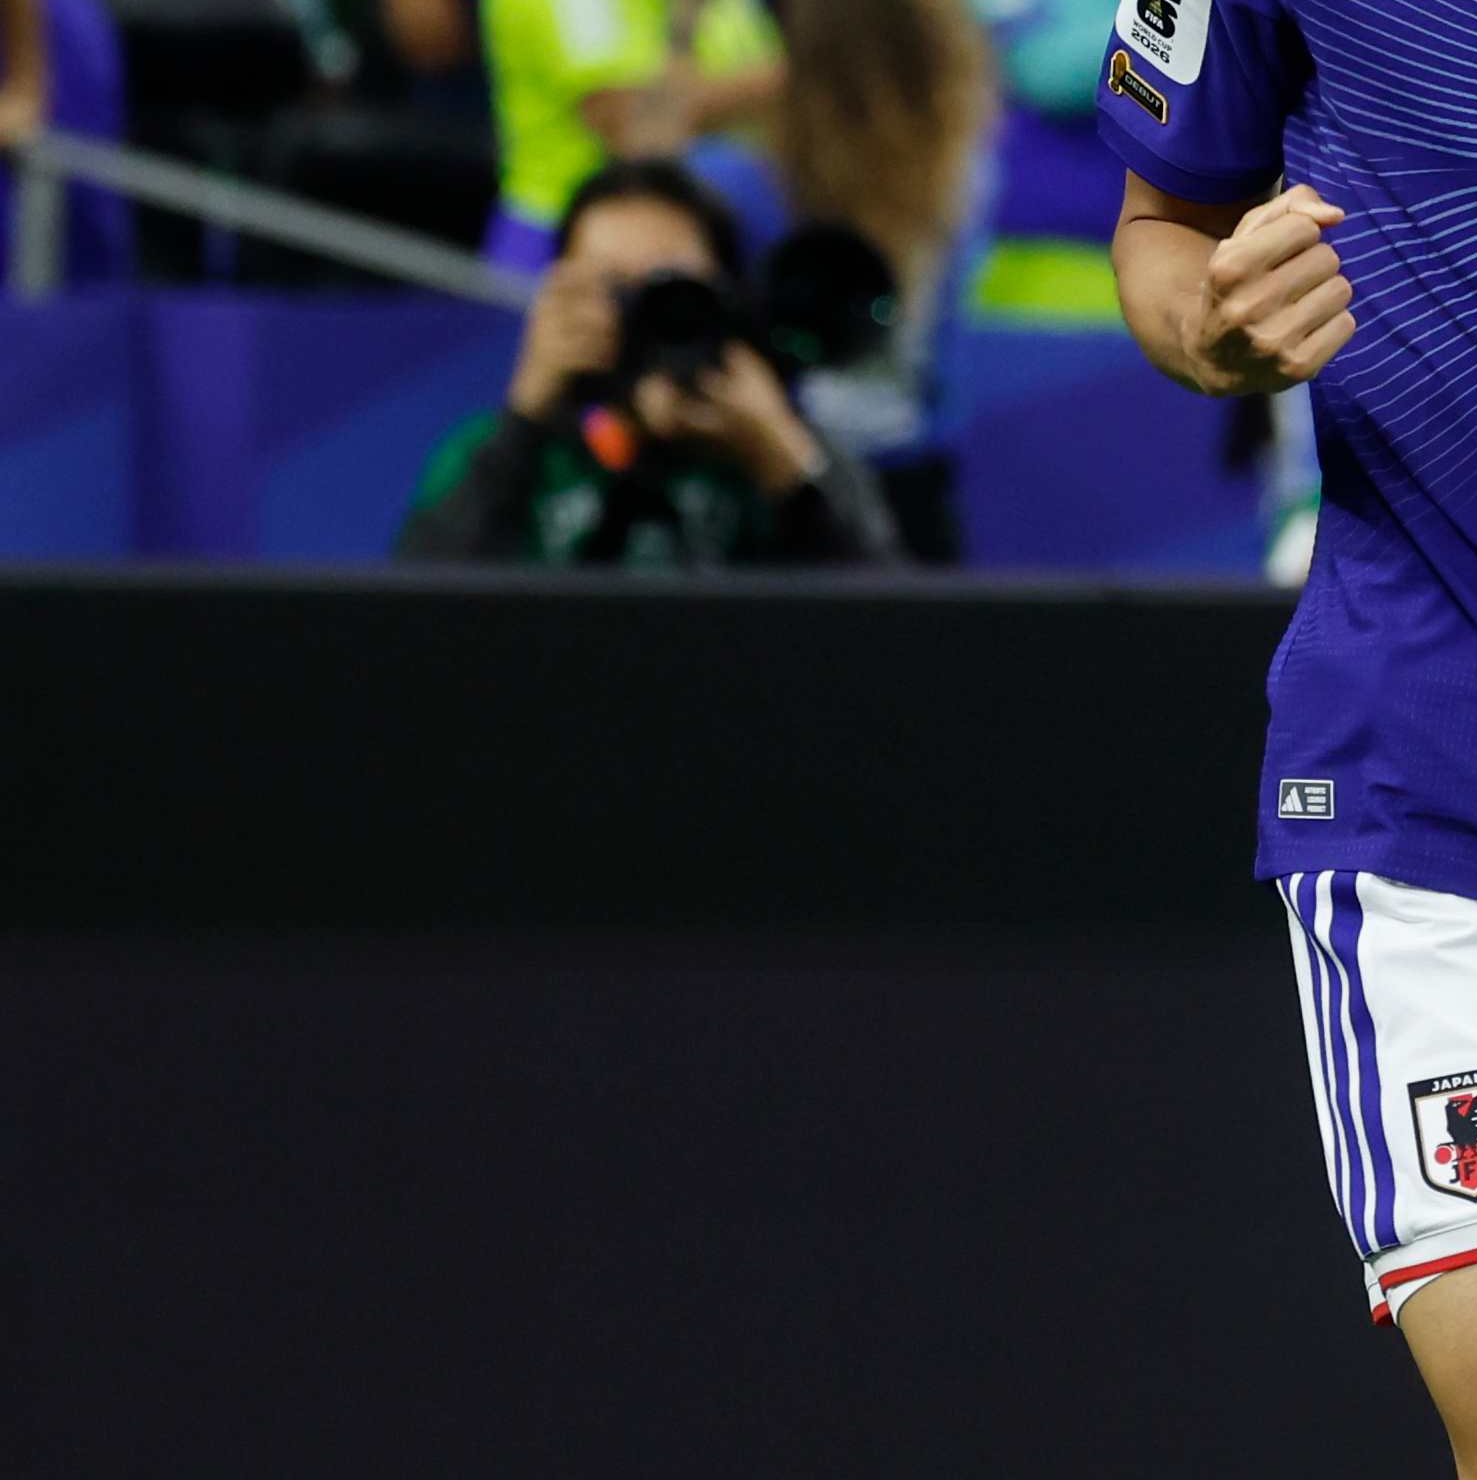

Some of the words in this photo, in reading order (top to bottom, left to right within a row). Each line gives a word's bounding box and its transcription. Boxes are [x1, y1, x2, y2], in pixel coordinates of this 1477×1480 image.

[1132, 19, 1157, 42] WORLD
[1157, 39, 1173, 52] CUP
[1144, 9, 1164, 30] FIFA
[1131, 28, 1170, 64] 2026
[1124, 74, 1161, 108] DEBUT
